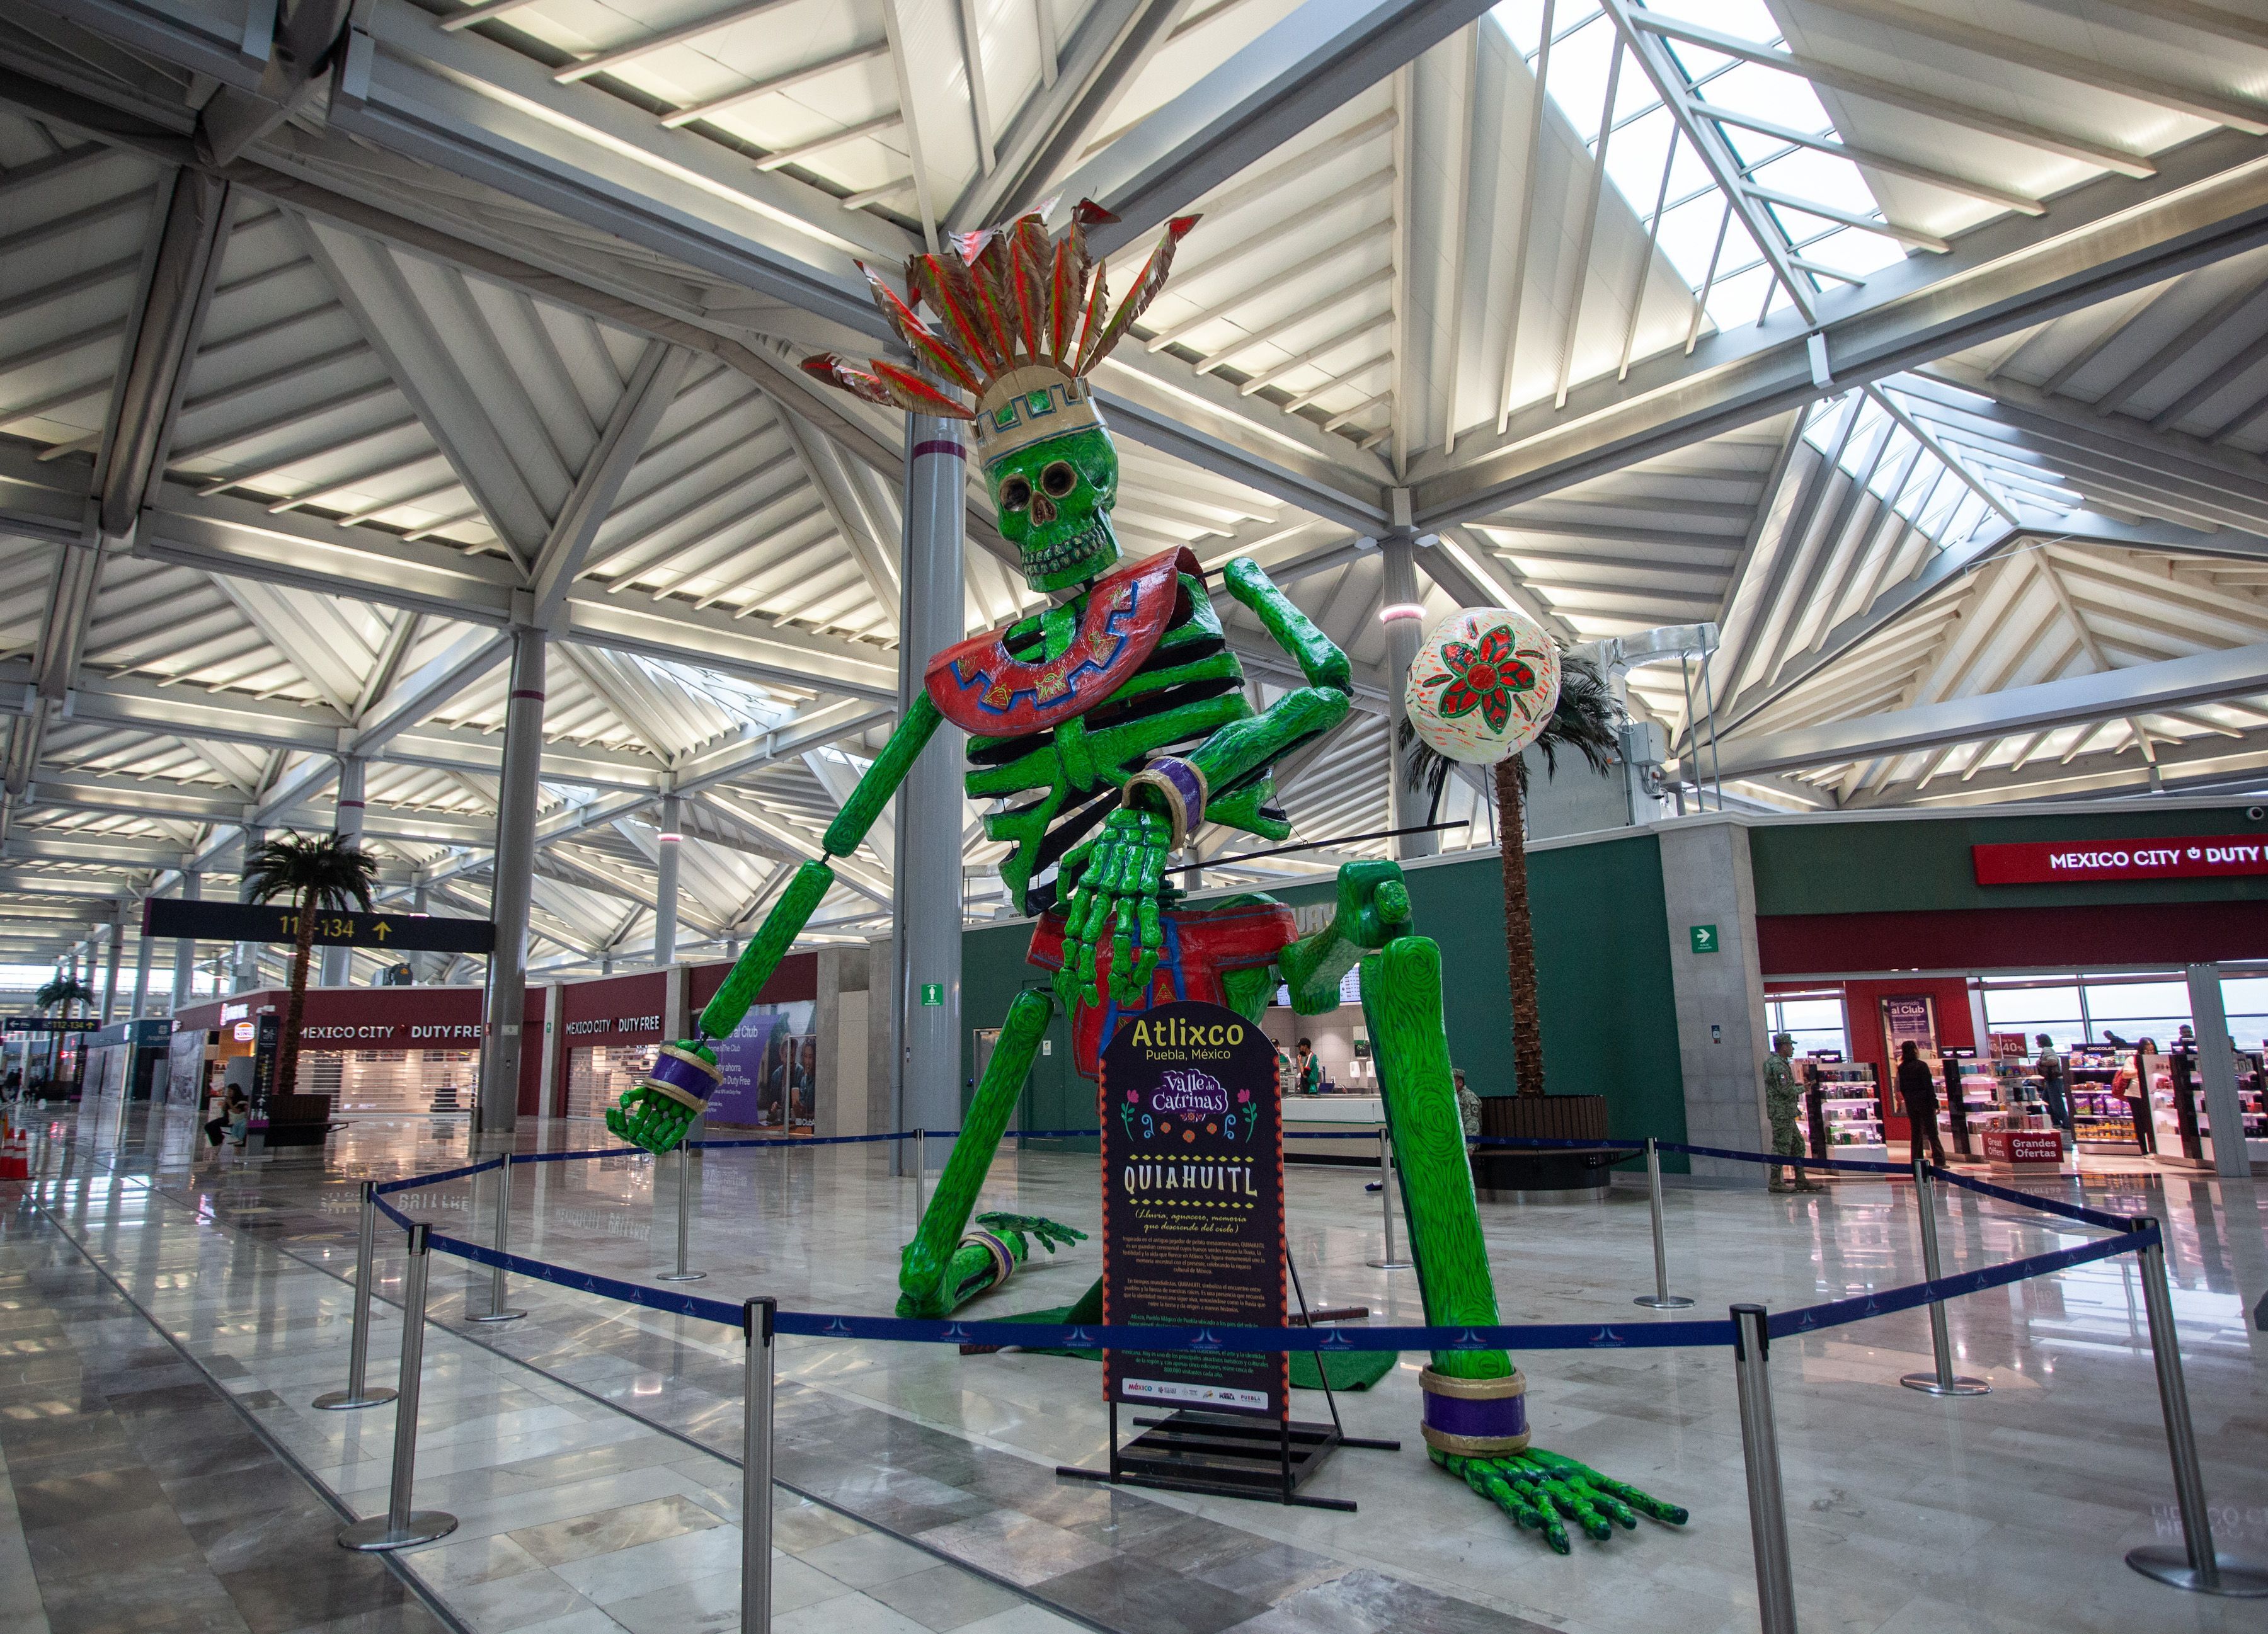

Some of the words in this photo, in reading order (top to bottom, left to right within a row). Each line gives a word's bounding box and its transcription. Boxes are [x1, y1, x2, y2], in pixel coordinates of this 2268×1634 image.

[2050, 852, 2129, 869] MEXICO
[2133, 849, 2180, 866] CITY
[2206, 846, 2259, 862] DUTY
[279, 915, 355, 938] 11-134
[1891, 1006, 1899, 1014] al
[1901, 1005, 1924, 1014] Club
[566, 1021, 593, 1035] MEXICO
[593, 1019, 611, 1032] CITY
[619, 1017, 639, 1032] DUTY
[640, 1015, 660, 1031] FREE
[299, 1026, 355, 1039] MEXICO
[358, 1026, 394, 1038] CITY
[411, 1026, 452, 1038] DUTY
[454, 1026, 481, 1037] FRE
[734, 1027, 740, 1038] al
[742, 1026, 758, 1038] Club
[1131, 1018, 1244, 1047] Atlixco
[731, 1044, 740, 1052] Club
[2003, 1043, 2025, 1052] 40%
[1146, 1049, 1188, 1061] Puebla,
[1191, 1048, 1230, 1060] México
[727, 1075, 739, 1087] Duty
[740, 1076, 750, 1085] Free
[1164, 1074, 1204, 1093] Valle
[1206, 1081, 1215, 1090] de
[1152, 1093, 1223, 1111] Catrinas
[1988, 1138, 2003, 1147] Great
[2012, 1139, 2056, 1148] Grandes
[1988, 1147, 2005, 1157] Offers
[2015, 1148, 2056, 1157] Ofertas
[1124, 1165, 1257, 1197] QUIAHUITL
[1171, 1214, 1208, 1223] aguacero,
[1144, 1224, 1159, 1233] que
[1161, 1221, 1199, 1231] desciende
[1201, 1223, 1214, 1231] del
[1128, 1383, 1152, 1391] México
